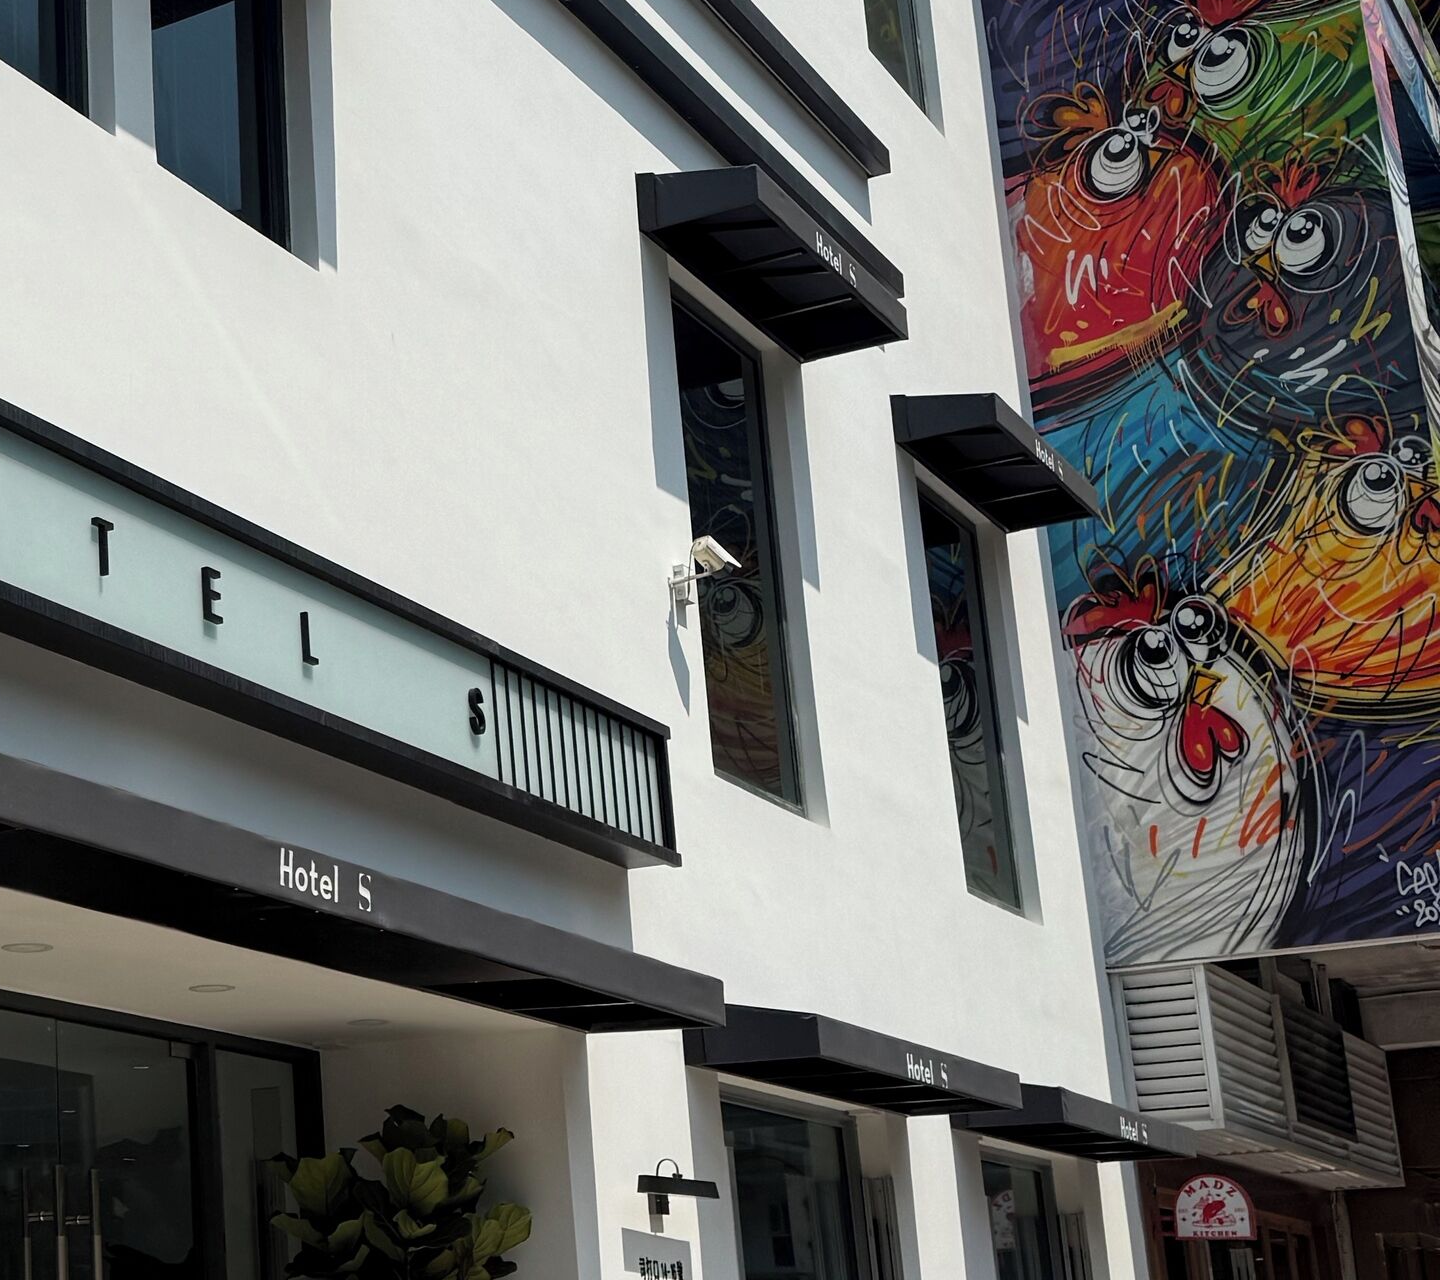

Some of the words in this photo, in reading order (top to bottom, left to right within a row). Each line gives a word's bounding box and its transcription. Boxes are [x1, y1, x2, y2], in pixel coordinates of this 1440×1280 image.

[815, 231, 842, 276] Hotel
[849, 263, 857, 288] S
[1034, 438, 1055, 472] Hotel
[1057, 460, 1064, 481] S
[468, 687, 486, 735] S
[280, 847, 339, 904] Hotel
[358, 873, 372, 912] S
[906, 1052, 935, 1085] Hotel
[940, 1062, 948, 1089] S
[1119, 1115, 1139, 1141] Hotel
[1141, 1123, 1148, 1145] S
[1183, 1179, 1237, 1198] MADZ
